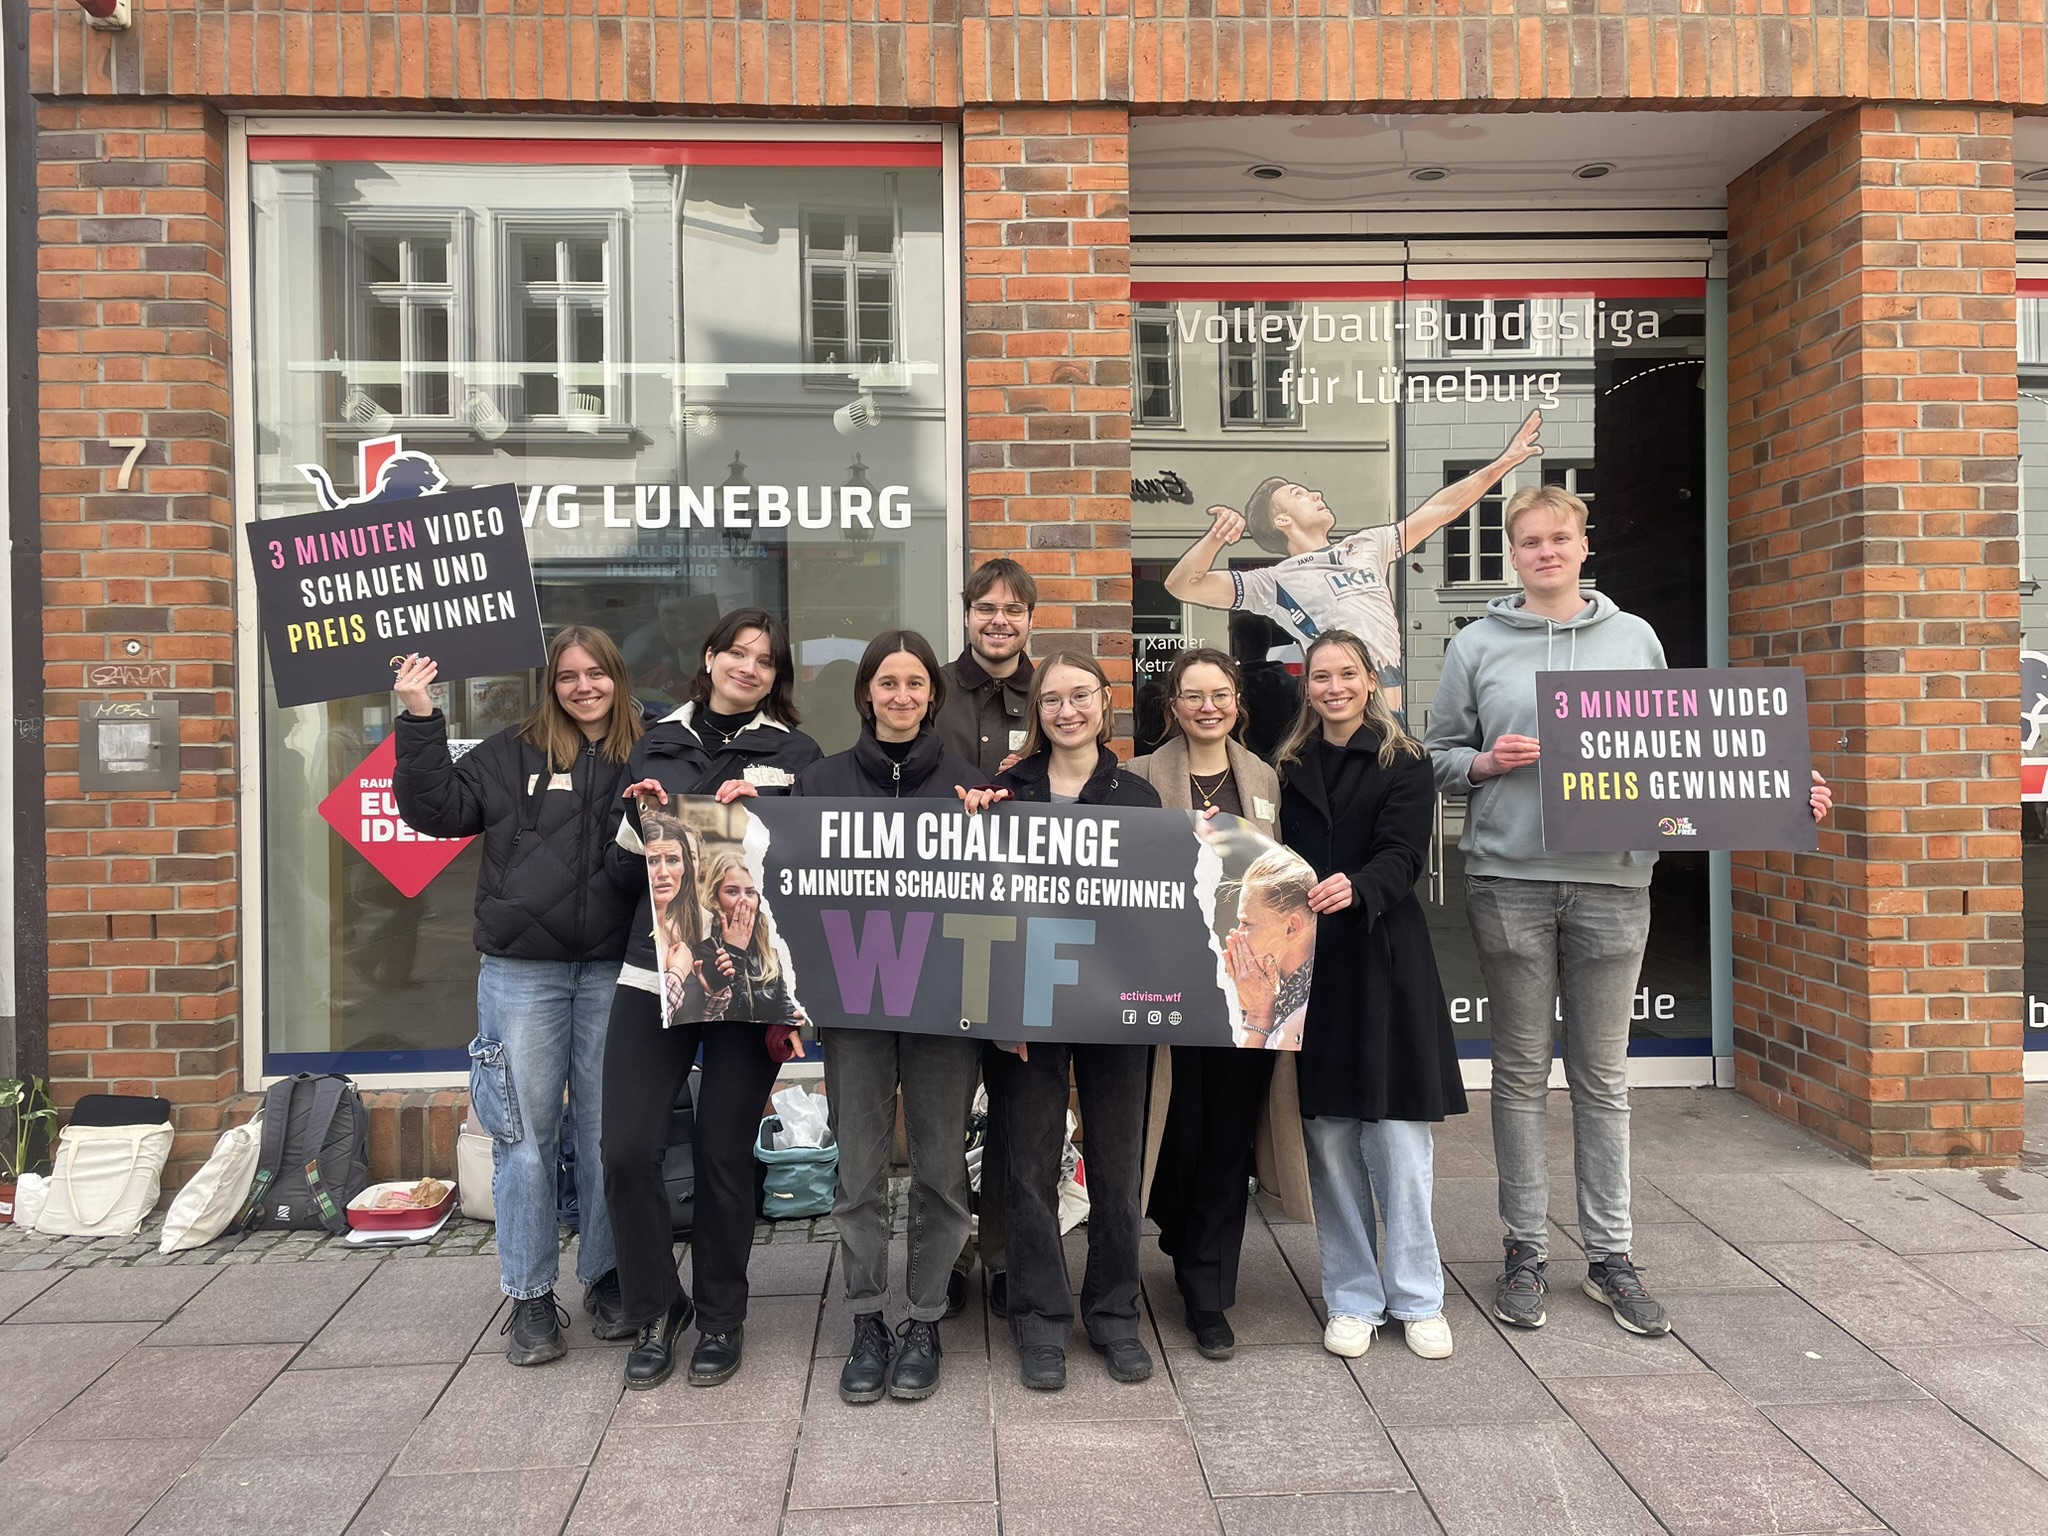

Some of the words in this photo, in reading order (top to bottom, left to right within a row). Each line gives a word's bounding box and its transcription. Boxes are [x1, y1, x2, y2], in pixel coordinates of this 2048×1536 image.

[1176, 302, 1660, 351] Volleyball-Bundesliga
[1278, 367, 1340, 405] für
[1356, 366, 1561, 410] Lüneburg
[109, 438, 146, 489] 7
[604, 484, 912, 530] LÜNEBURG
[268, 540, 286, 570] 3
[294, 520, 416, 566] MINUTEN
[424, 506, 505, 546] VIDEO
[555, 545, 659, 558] VOLLEYBALL
[661, 545, 768, 558] BUNDESLIGA
[300, 561, 424, 608] SCHAUEN
[432, 552, 488, 588] UND
[606, 564, 625, 577] IN
[287, 613, 366, 653] PREIS
[375, 590, 516, 639] GEWINNEN
[1146, 635, 1205, 650] Xander
[1554, 690, 1569, 719] 3
[1580, 689, 1698, 718] MINUTEN
[1708, 687, 1788, 717] VIDEO
[1580, 729, 1701, 760] SCHAUEN
[1712, 728, 1767, 758] UND
[1563, 771, 1639, 801] PREIS
[1649, 769, 1791, 800] GEWINNEN
[820, 810, 905, 859] FILM
[916, 811, 1120, 868] CHALLENGE
[780, 868, 793, 896] 3
[798, 868, 890, 897] MINUTEN
[895, 869, 985, 901] SCHAUEN
[989, 872, 1006, 901] &
[1011, 874, 1070, 905] PREIS
[1075, 878, 1185, 910] GEWINNEN
[820, 909, 1096, 1027] WTF
[1120, 991, 1182, 1002] activism.wtf
